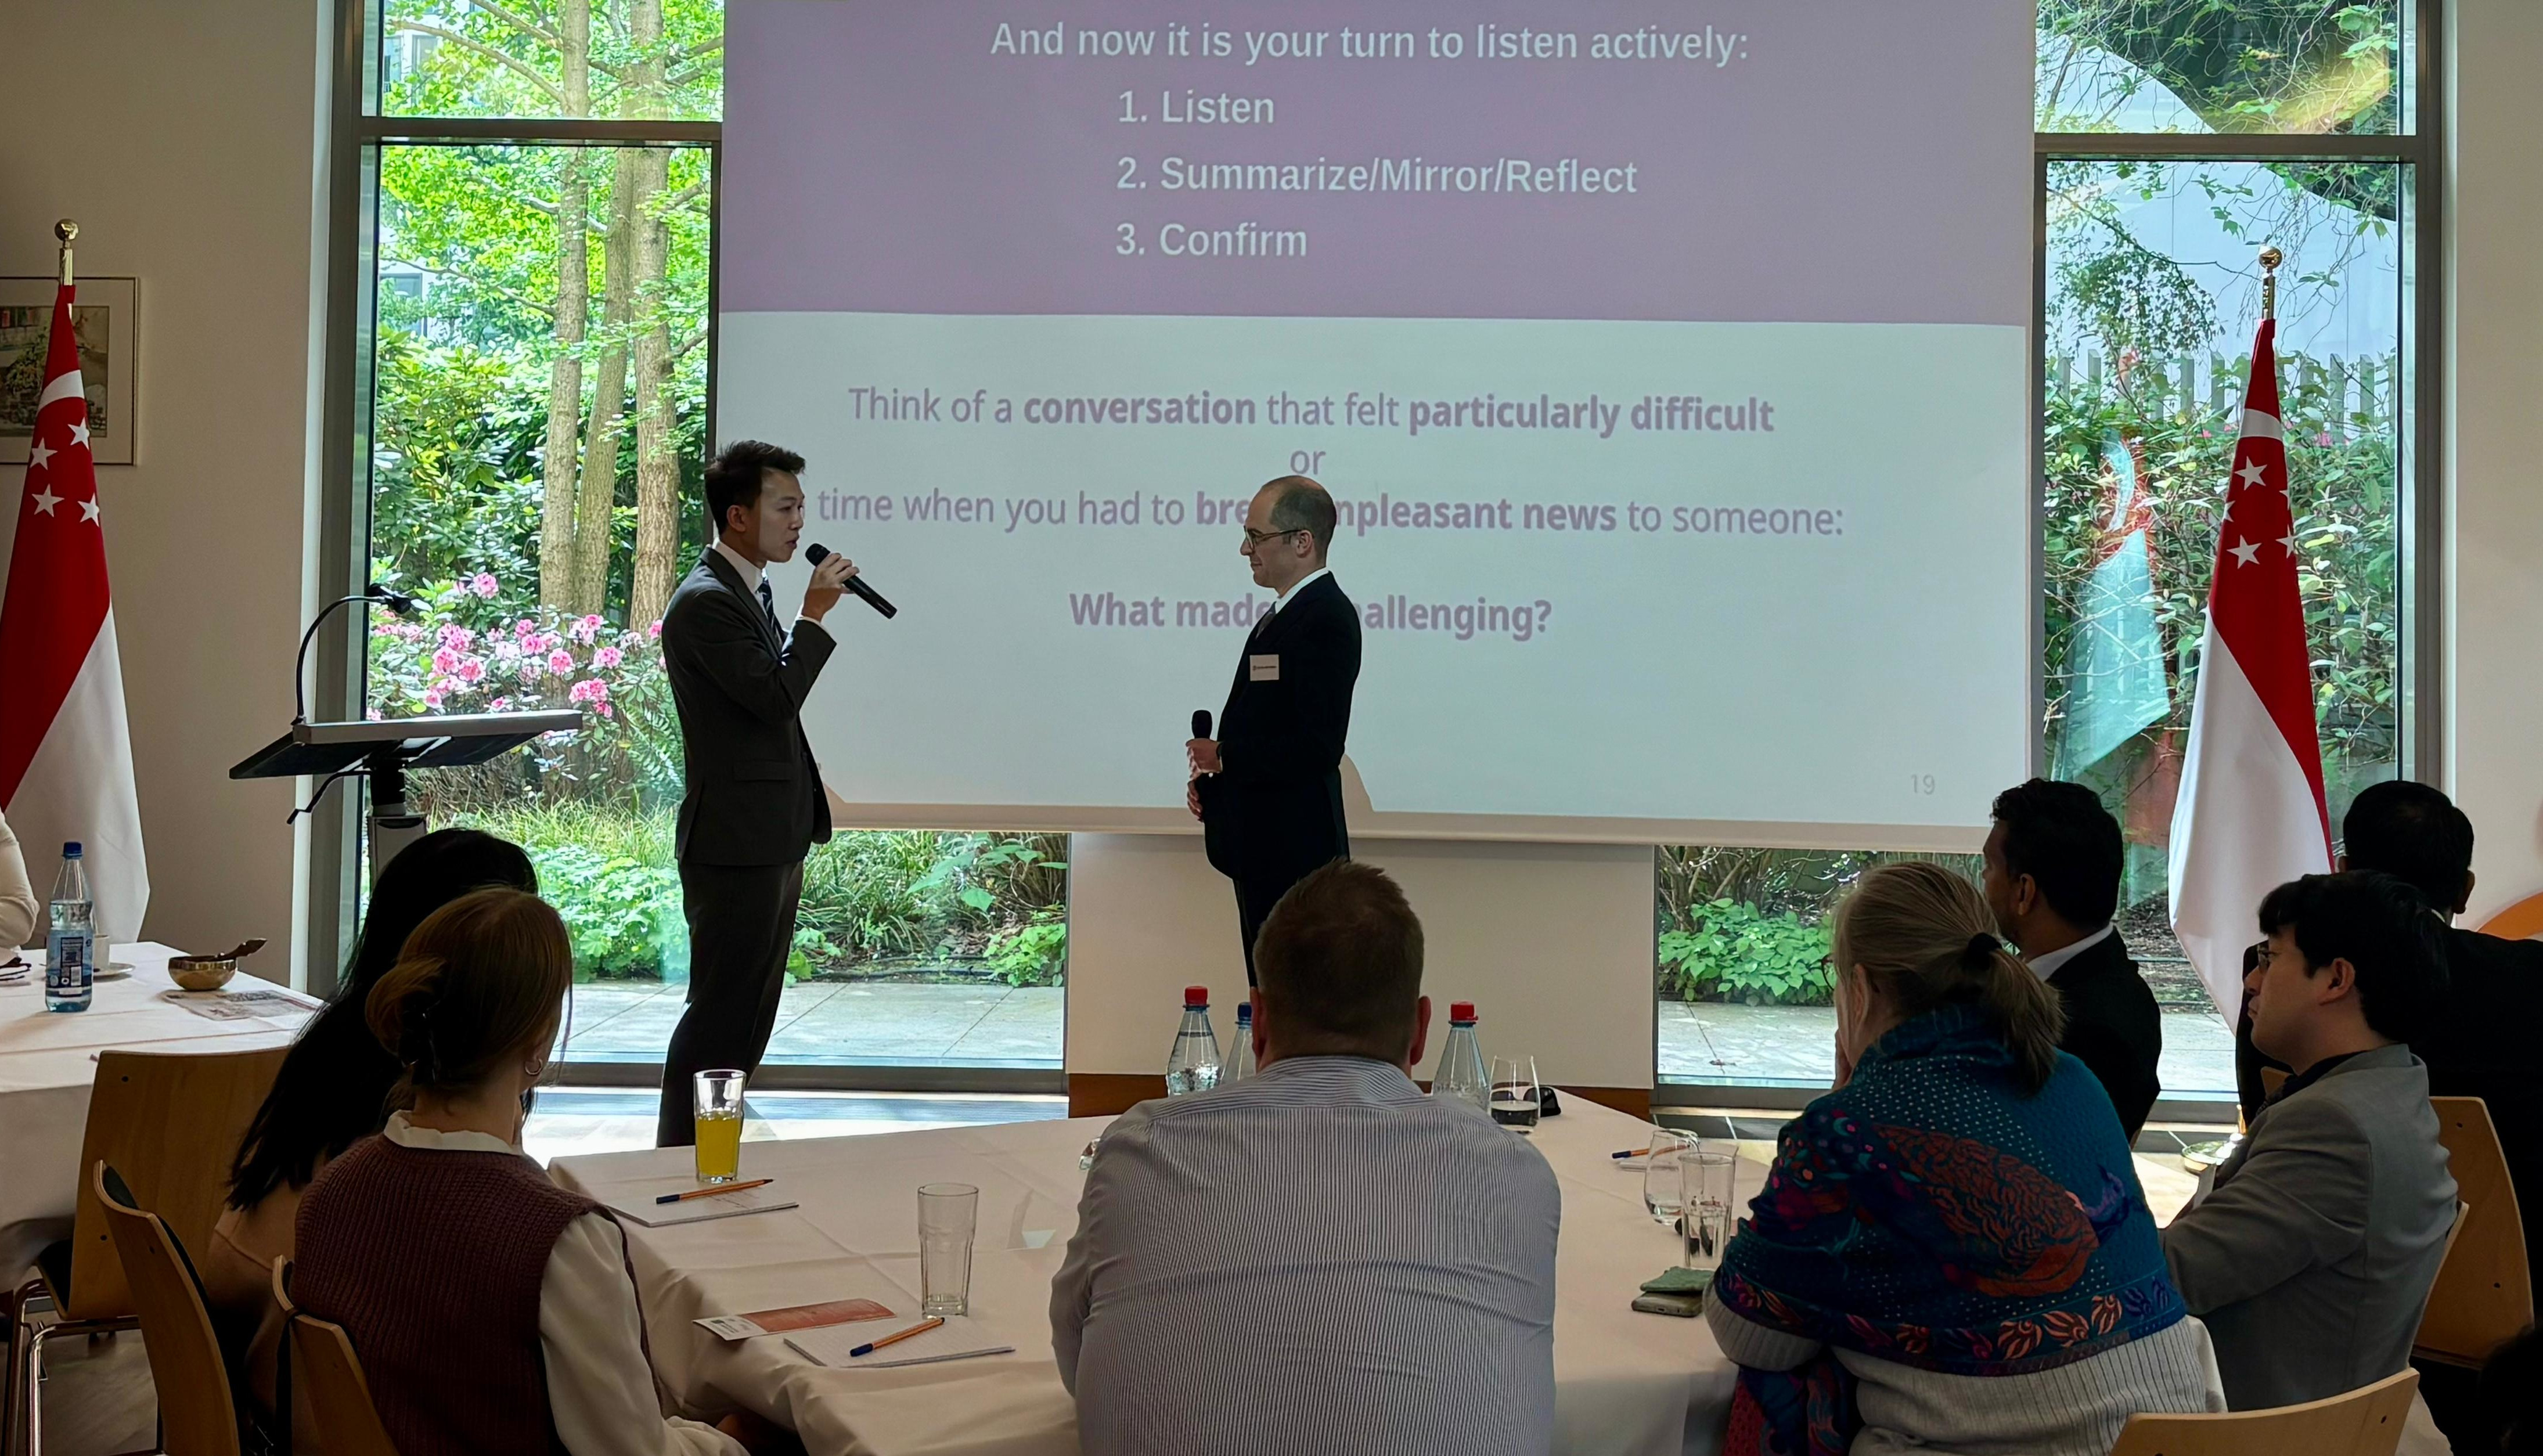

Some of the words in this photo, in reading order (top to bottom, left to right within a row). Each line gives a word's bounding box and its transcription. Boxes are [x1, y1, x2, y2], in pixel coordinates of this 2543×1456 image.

[990, 21, 1064, 56] And
[1078, 30, 1156, 57] now
[1168, 21, 1191, 57] it
[1202, 22, 1233, 57] is
[1244, 31, 1330, 66] your
[1339, 26, 1415, 59] turn
[1427, 26, 1464, 59] to
[1477, 23, 1578, 59] listen
[1590, 24, 1748, 69] actively:
[1118, 89, 1148, 123] 1.
[1162, 89, 1274, 124] Listen
[1116, 156, 1147, 190] 2.
[1161, 156, 1638, 194] Summarize/Mirror/Reflect
[1115, 222, 1146, 256] 3.
[1159, 222, 1307, 257] Confirm
[848, 385, 942, 422] Think
[950, 388, 987, 423] of
[993, 398, 1013, 424] a
[1024, 390, 1256, 425] conversation
[1266, 390, 1335, 426] that
[1344, 391, 1400, 427] felt
[1409, 392, 1622, 439] particularly
[1630, 395, 1775, 433] difficult
[1289, 449, 1327, 475] or
[817, 487, 893, 522] time
[903, 487, 995, 524] when
[1004, 498, 1067, 534] you
[1078, 490, 1141, 526] had
[1151, 494, 1186, 526] to
[1196, 491, 1250, 525] bre
[1335, 492, 1513, 537] npleasant
[1523, 503, 1618, 532] news
[1627, 500, 1662, 533] to
[1673, 506, 1843, 536] someone:
[1069, 591, 1166, 628] What
[1354, 593, 1552, 641] allenging?
[1911, 774, 1936, 795] 19
